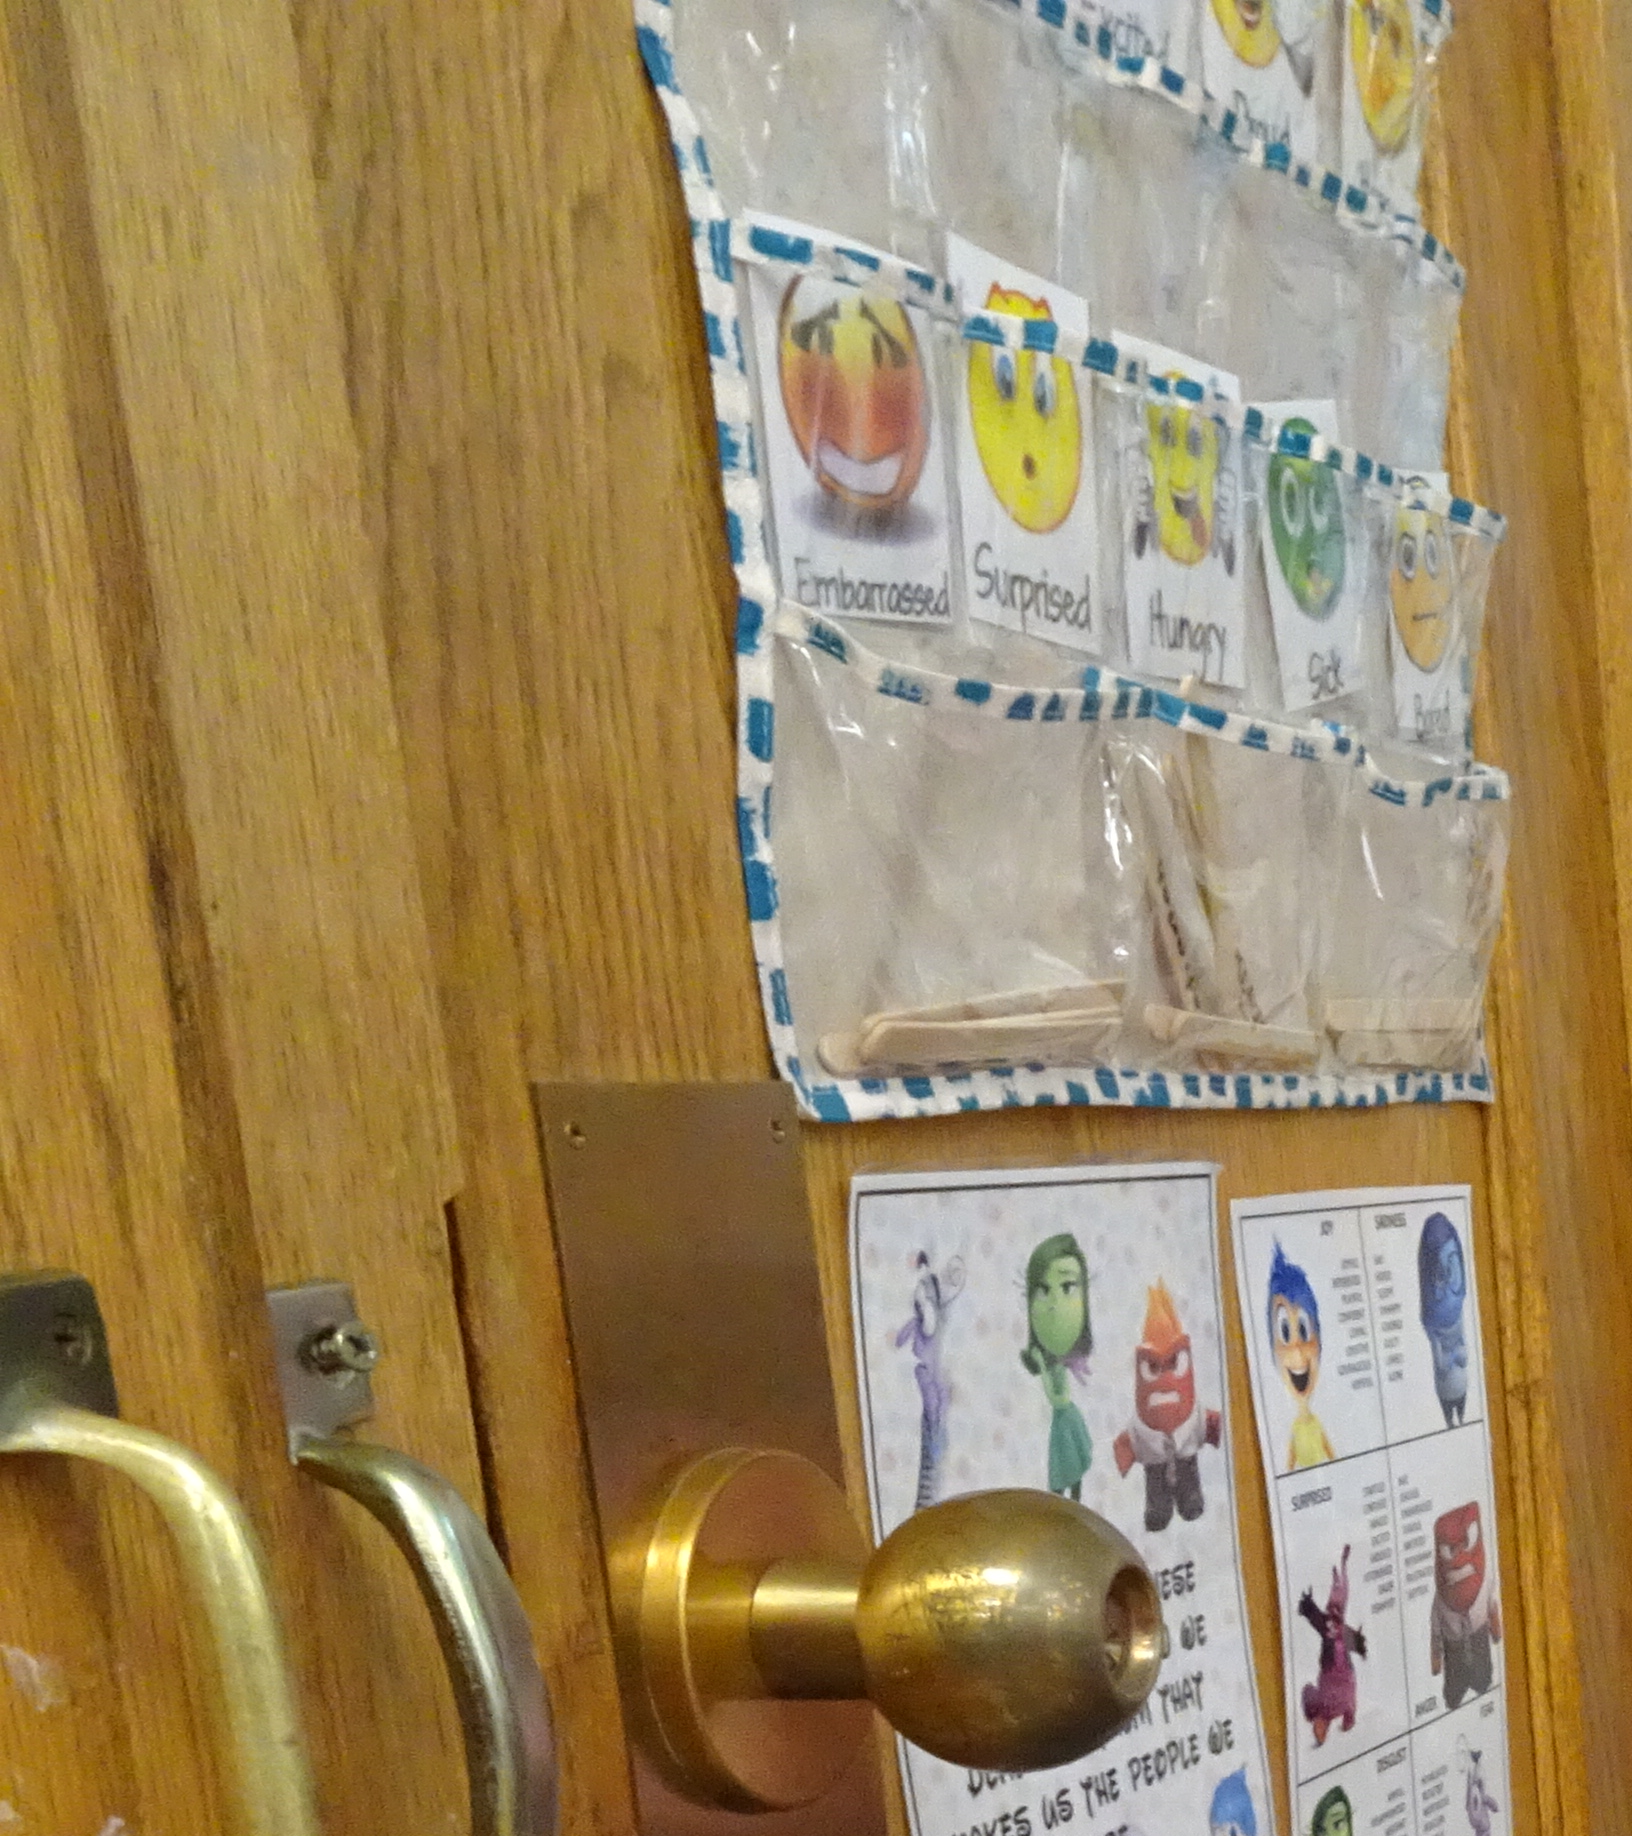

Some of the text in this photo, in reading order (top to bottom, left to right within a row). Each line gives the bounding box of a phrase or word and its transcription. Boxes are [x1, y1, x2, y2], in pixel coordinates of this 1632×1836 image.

[794, 556, 950, 618] Embarrassed
[973, 541, 1092, 635] Surprised
[1149, 589, 1227, 683] Hungry
[1307, 647, 1345, 700] Sick
[1156, 1561, 1196, 1600] ESE
[1042, 1788, 1073, 1830] US
[1080, 1769, 1118, 1818] THE
[1128, 1733, 1199, 1790] PEOPLE
[1208, 1719, 1234, 1755] WE
